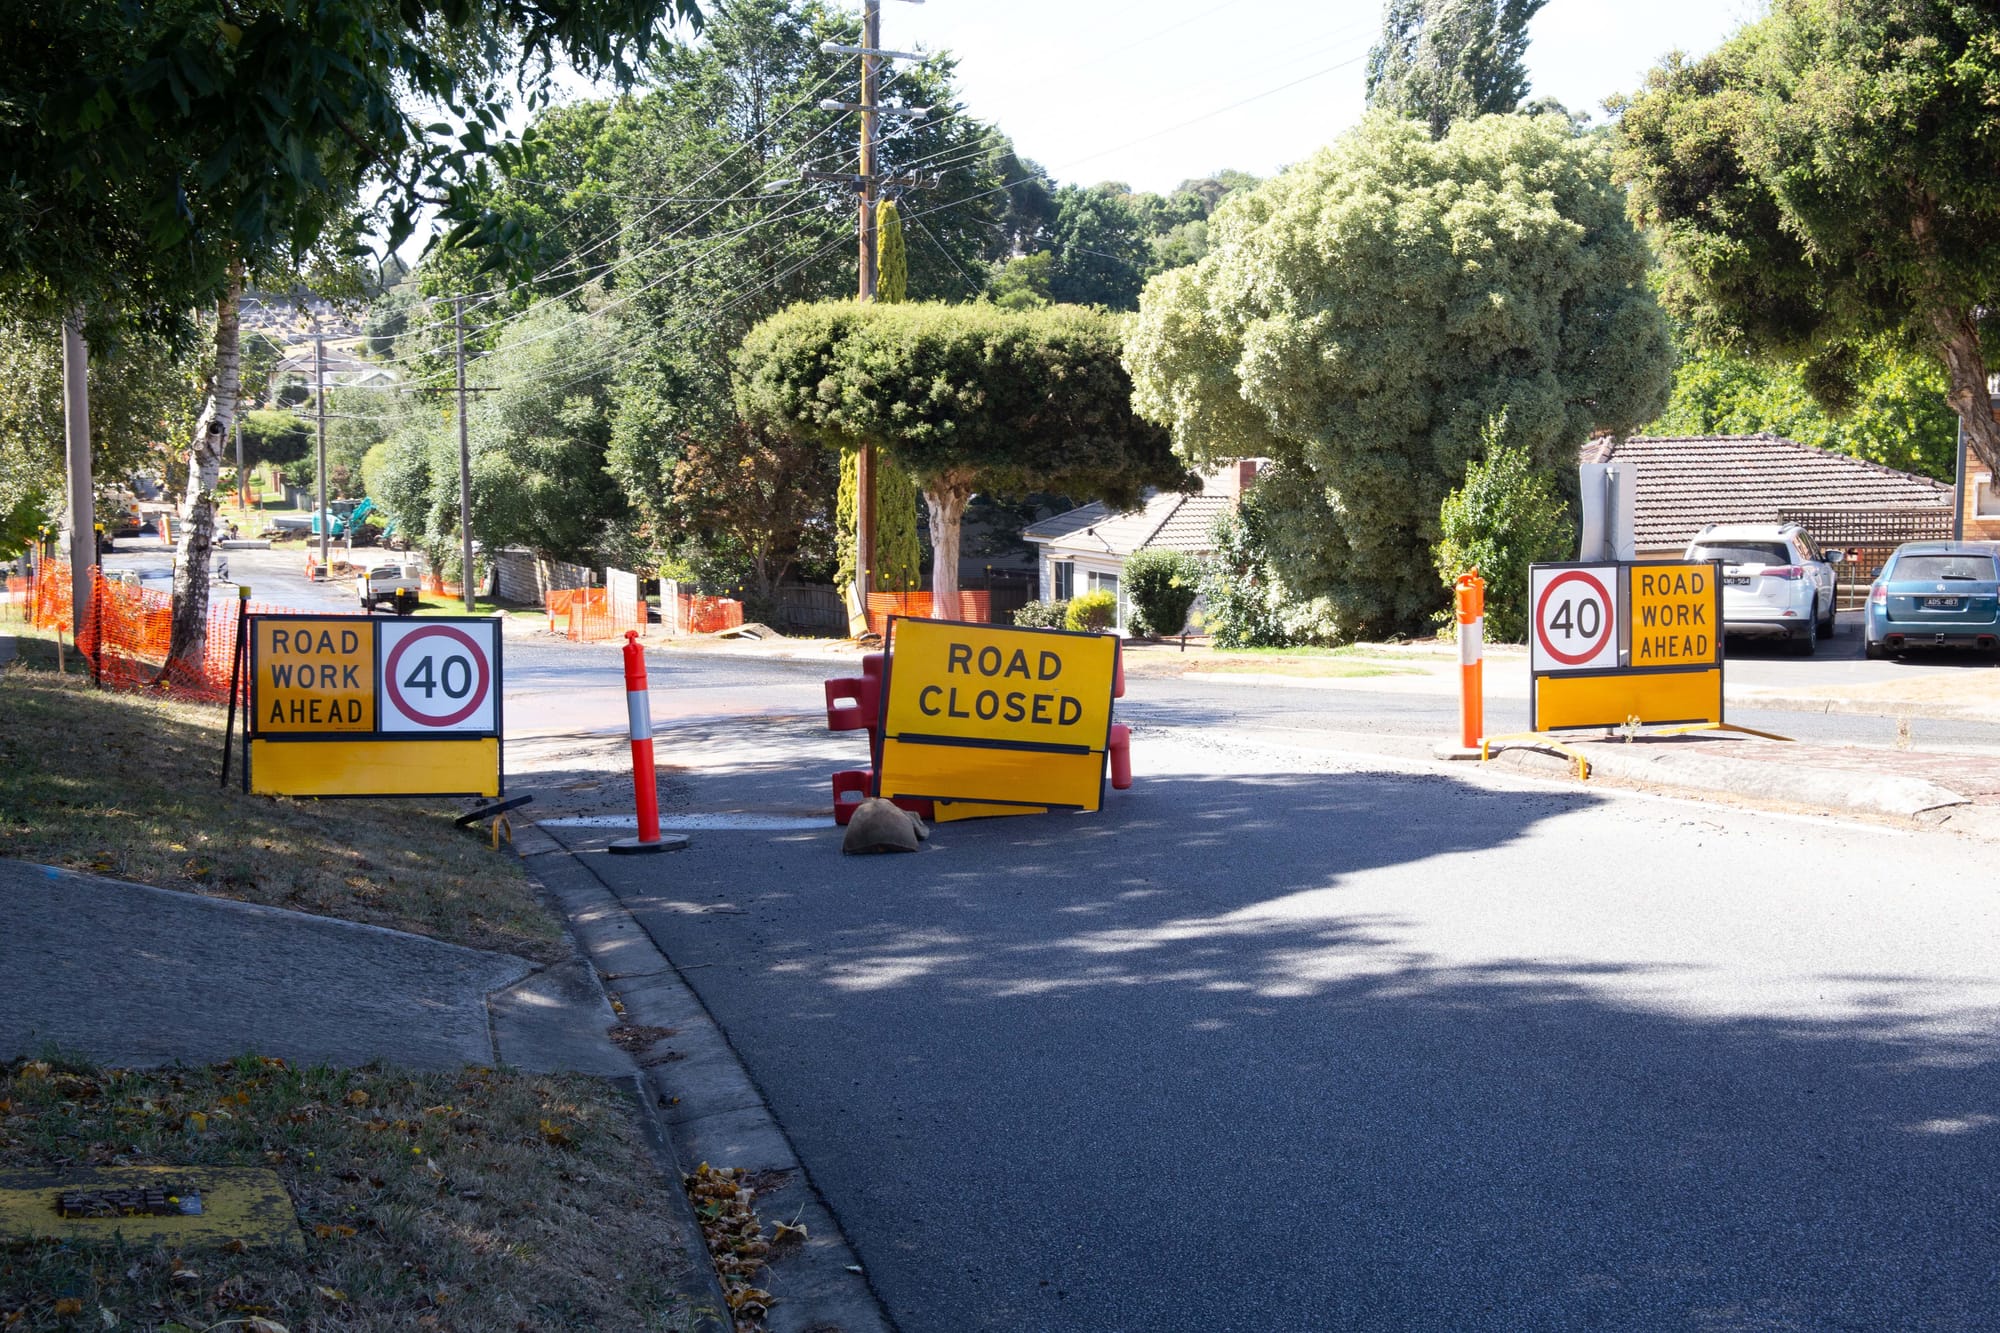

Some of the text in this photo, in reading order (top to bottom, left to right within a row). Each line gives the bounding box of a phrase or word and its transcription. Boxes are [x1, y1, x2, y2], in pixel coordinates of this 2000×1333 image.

[1642, 573, 1704, 596] ROAD
[1549, 598, 1600, 639] 40
[1641, 603, 1706, 627] WORK
[272, 629, 359, 654] ROAD
[1640, 634, 1707, 658] AHEAD
[948, 643, 1062, 681] ROAD
[271, 664, 360, 689] WORK
[404, 654, 472, 699] 40
[269, 699, 362, 724] AHEAD
[919, 685, 1082, 726] CLOSED
